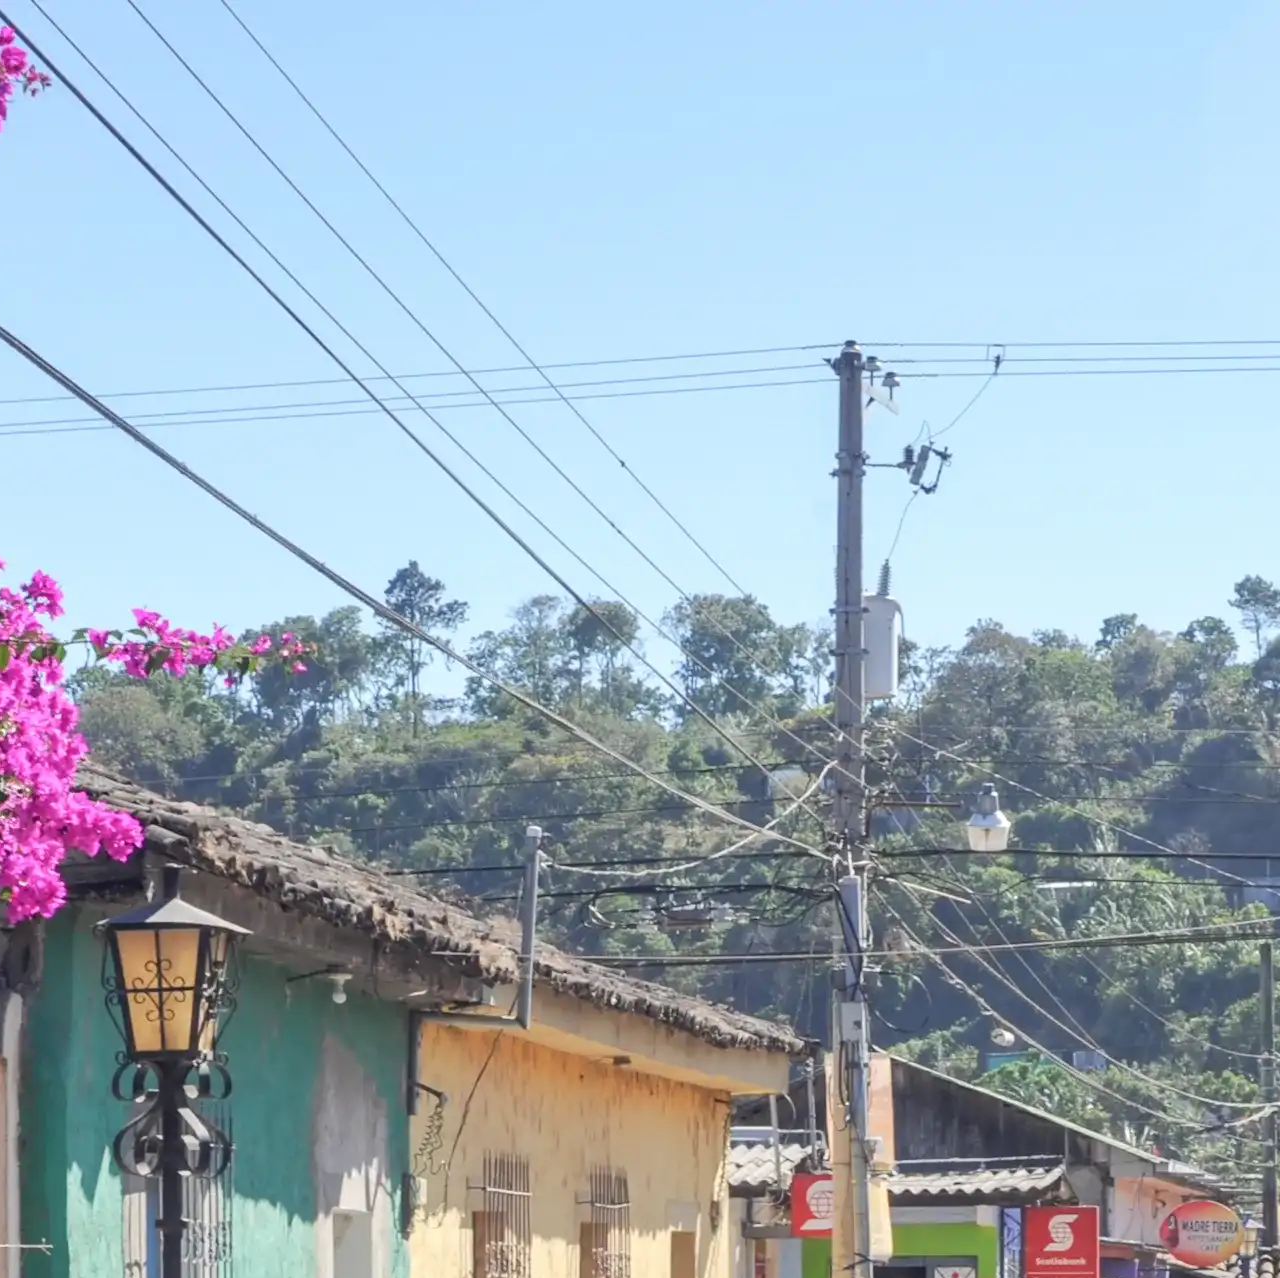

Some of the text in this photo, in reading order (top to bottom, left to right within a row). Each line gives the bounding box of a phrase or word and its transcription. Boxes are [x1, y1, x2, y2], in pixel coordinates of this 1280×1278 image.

[1182, 1220, 1238, 1234] MADRE TIERRA
[1035, 1257, 1087, 1266] Scotiabank
